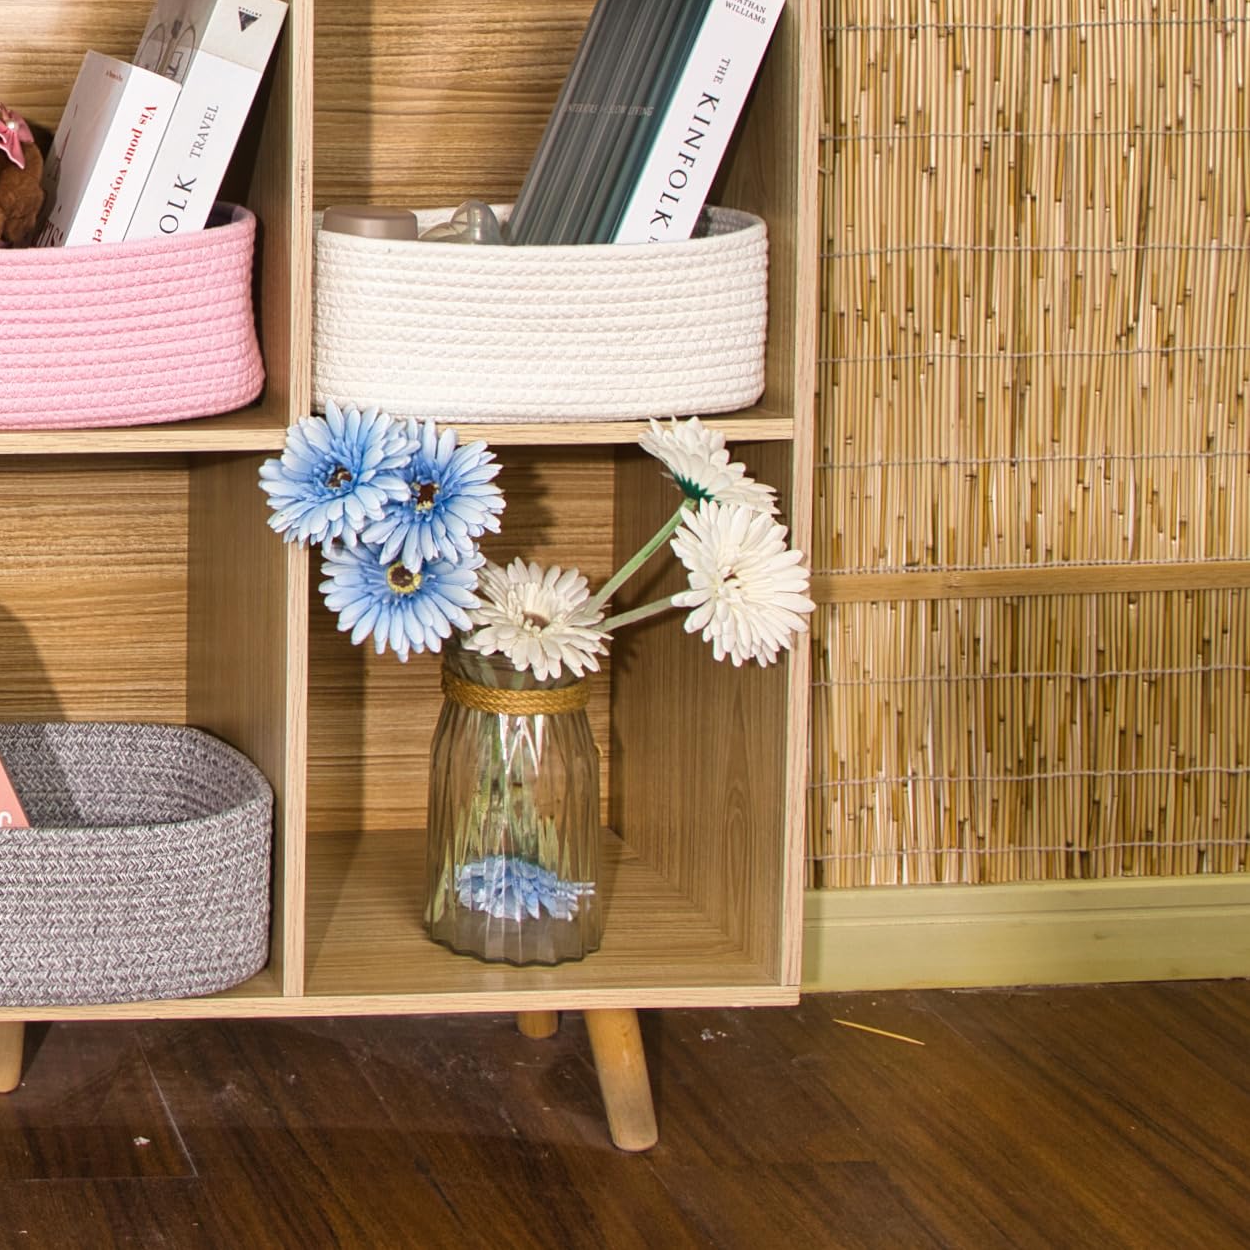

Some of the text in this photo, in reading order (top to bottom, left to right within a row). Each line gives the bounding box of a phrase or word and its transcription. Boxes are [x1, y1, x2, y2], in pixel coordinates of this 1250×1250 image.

[725, 0, 767, 25] WILLIAMS
[139, 106, 158, 125] Vis
[124, 127, 143, 164] pour
[650, 58, 731, 230] THE KINFOLK
[153, 105, 219, 238] OLK TRAVEL
[100, 169, 128, 225] voyager
